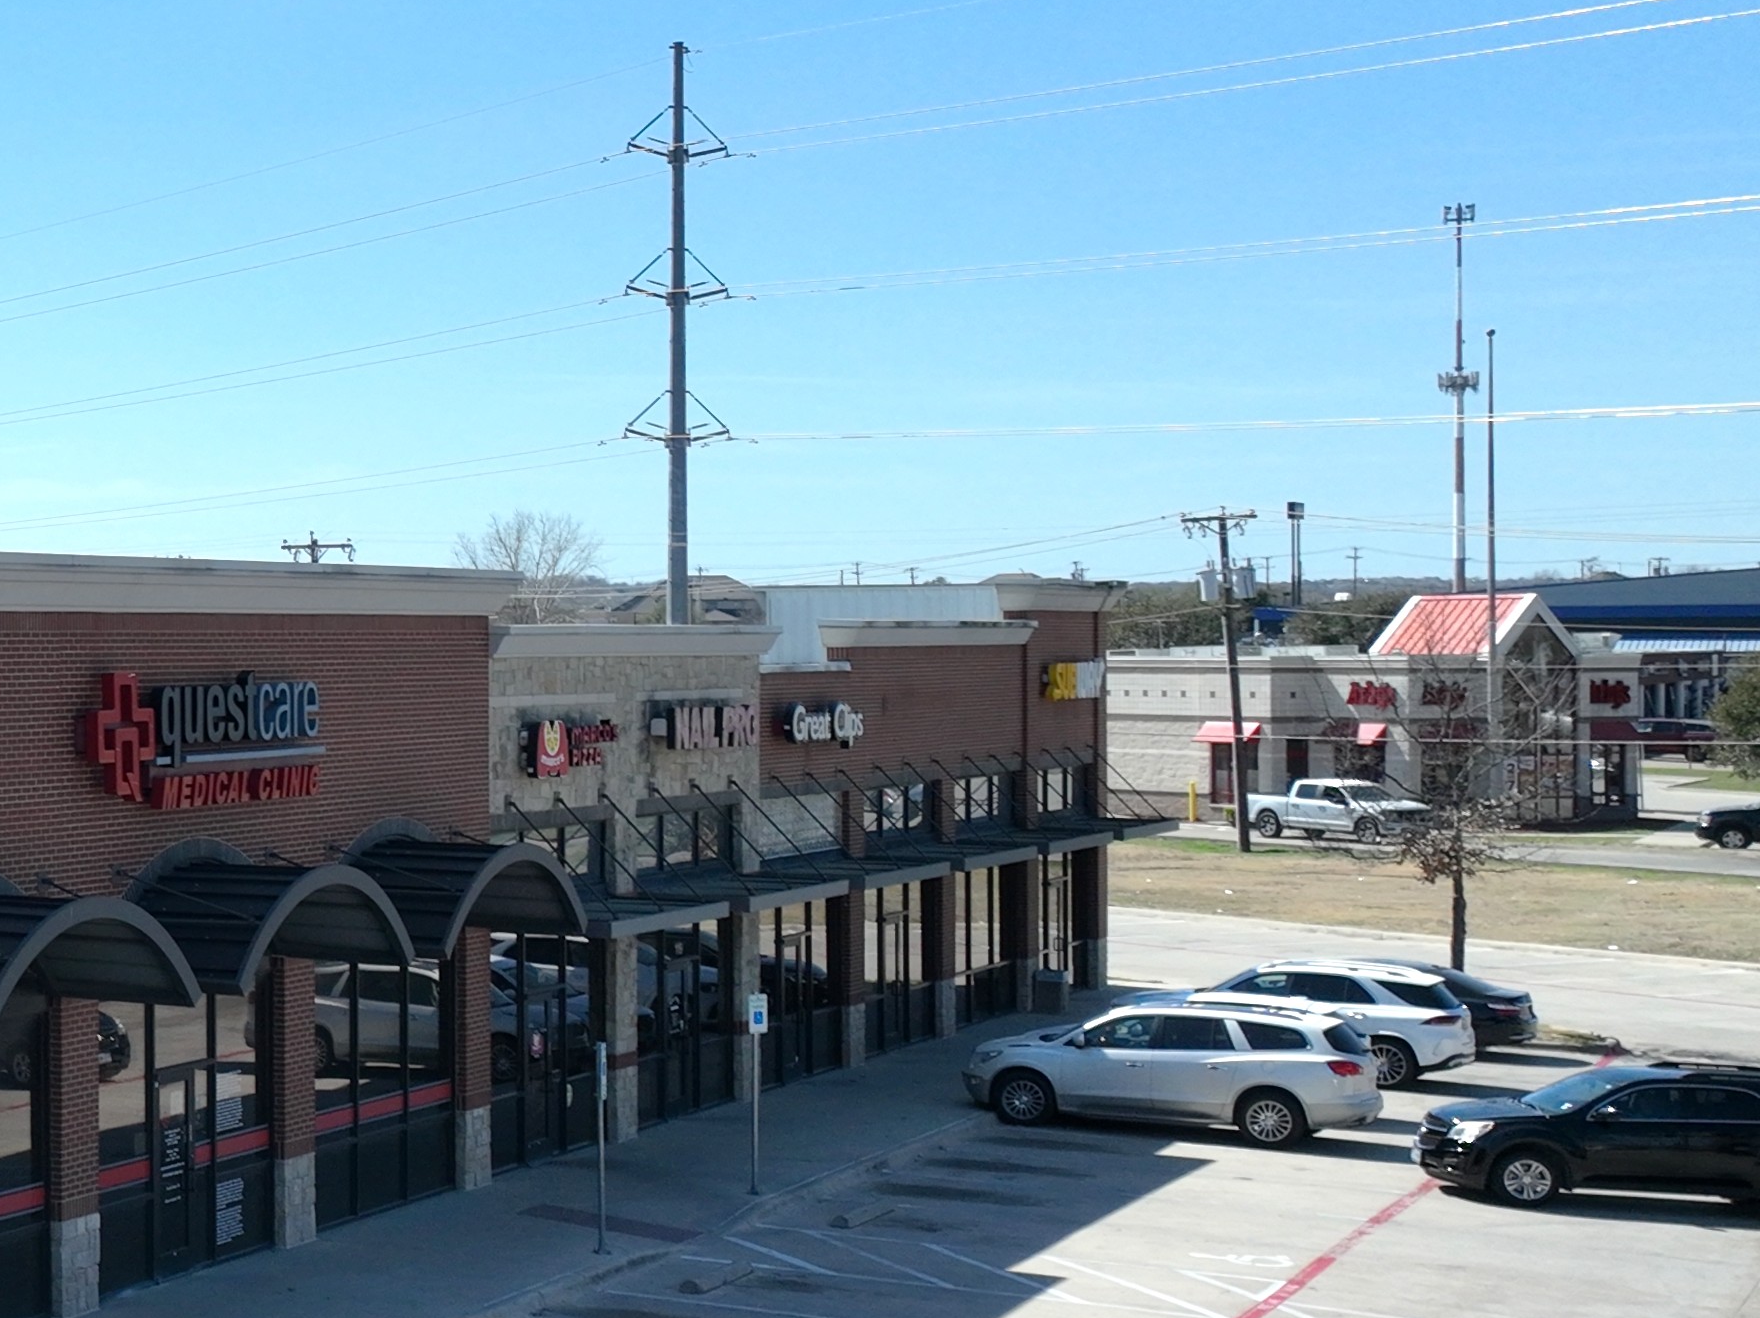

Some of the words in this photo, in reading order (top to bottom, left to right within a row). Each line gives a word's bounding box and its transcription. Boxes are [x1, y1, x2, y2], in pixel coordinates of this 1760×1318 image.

[160, 671, 321, 769] questcare
[675, 706, 720, 750] NAIL
[722, 704, 757, 748] PRO
[792, 704, 832, 742] Great
[572, 747, 602, 767] PIZZA
[161, 770, 251, 810] MEDICAL
[258, 764, 322, 801] CLINIC
